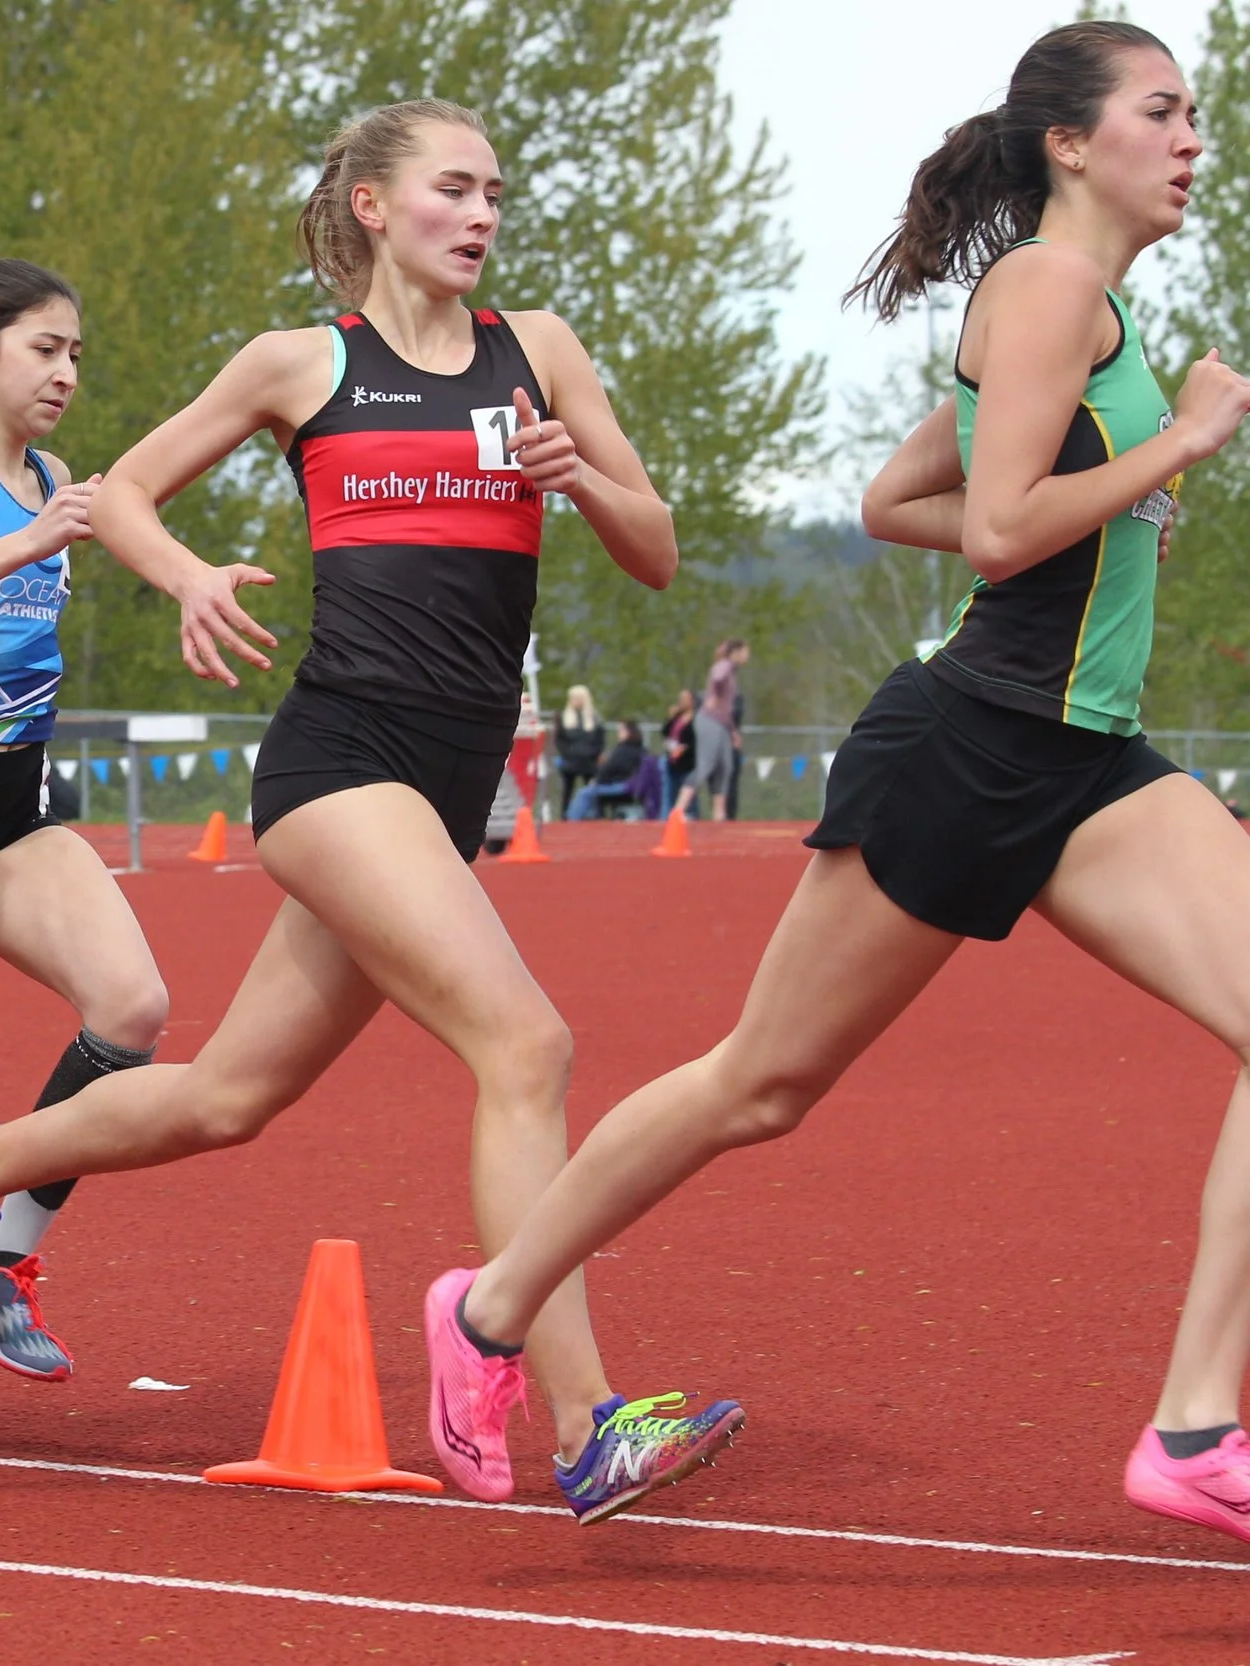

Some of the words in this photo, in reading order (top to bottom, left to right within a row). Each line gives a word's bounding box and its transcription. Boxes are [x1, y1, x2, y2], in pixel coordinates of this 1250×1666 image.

[369, 391, 422, 403] KUKRI
[488, 410, 522, 466] 1
[343, 471, 428, 504] Hershey
[435, 471, 518, 502] Harriers
